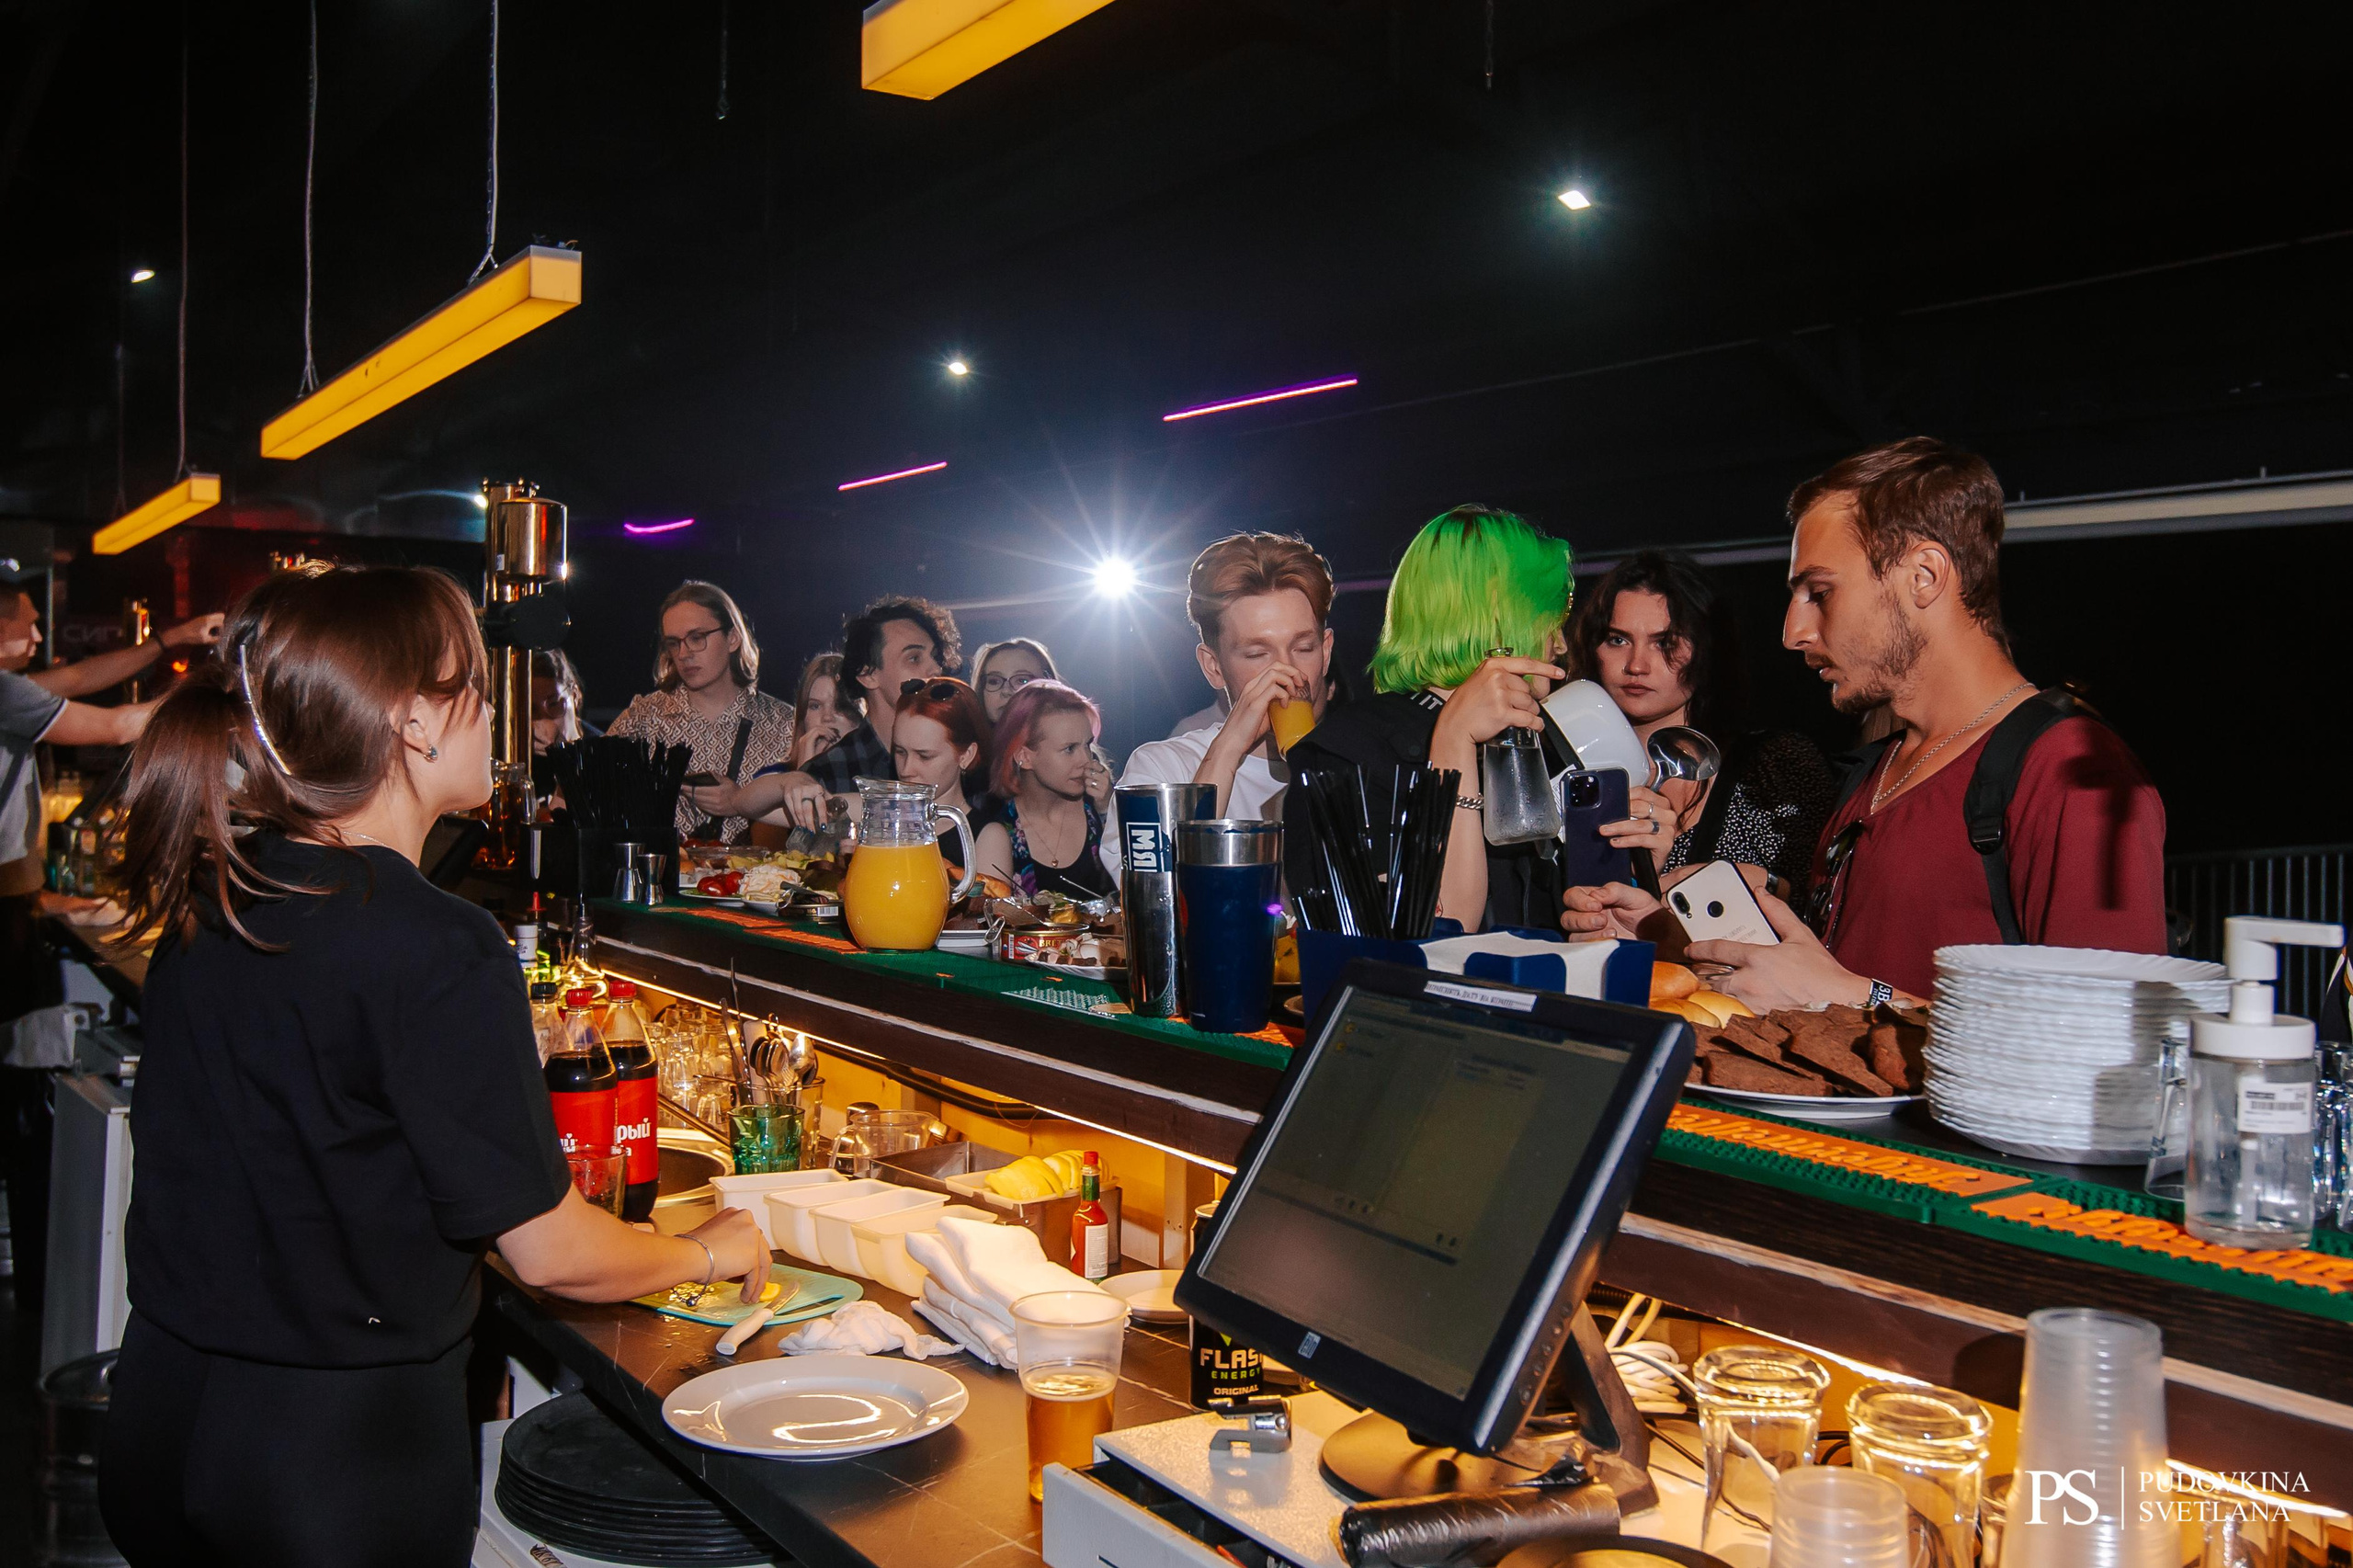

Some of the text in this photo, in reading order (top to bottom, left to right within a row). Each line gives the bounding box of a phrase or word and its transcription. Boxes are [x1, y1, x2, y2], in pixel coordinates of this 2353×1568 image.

[1131, 829, 1158, 873] МЯ
[617, 1118, 651, 1144] рый
[1199, 1347, 1262, 1369] FLAS
[1211, 1367, 1261, 1380] ENERGY
[1213, 1384, 1259, 1396] ORIGINAL
